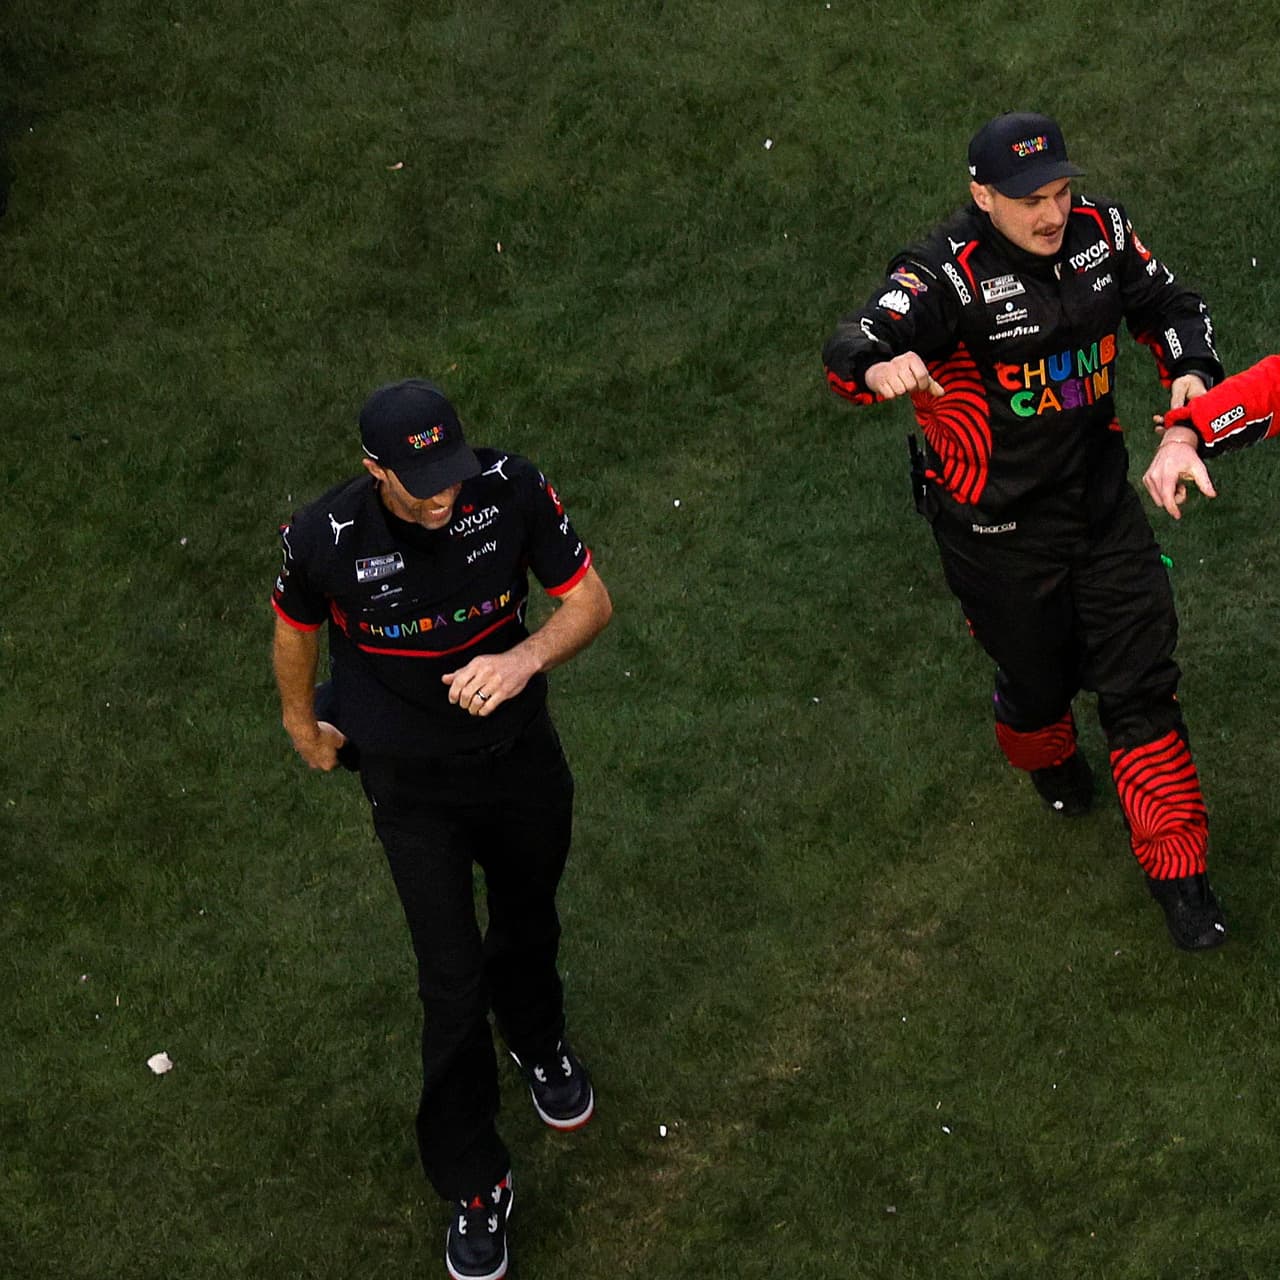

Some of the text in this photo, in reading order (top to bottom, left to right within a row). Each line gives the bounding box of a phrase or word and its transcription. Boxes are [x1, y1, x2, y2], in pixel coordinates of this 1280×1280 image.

[941, 262, 972, 306] sparco
[1091, 273, 1113, 294] xfini
[988, 324, 1041, 342] GOODYEAR
[993, 333, 1116, 391] CHUMB
[1010, 366, 1110, 417] CASIN
[1210, 405, 1245, 433] sparco
[453, 590, 511, 623] CASIN
